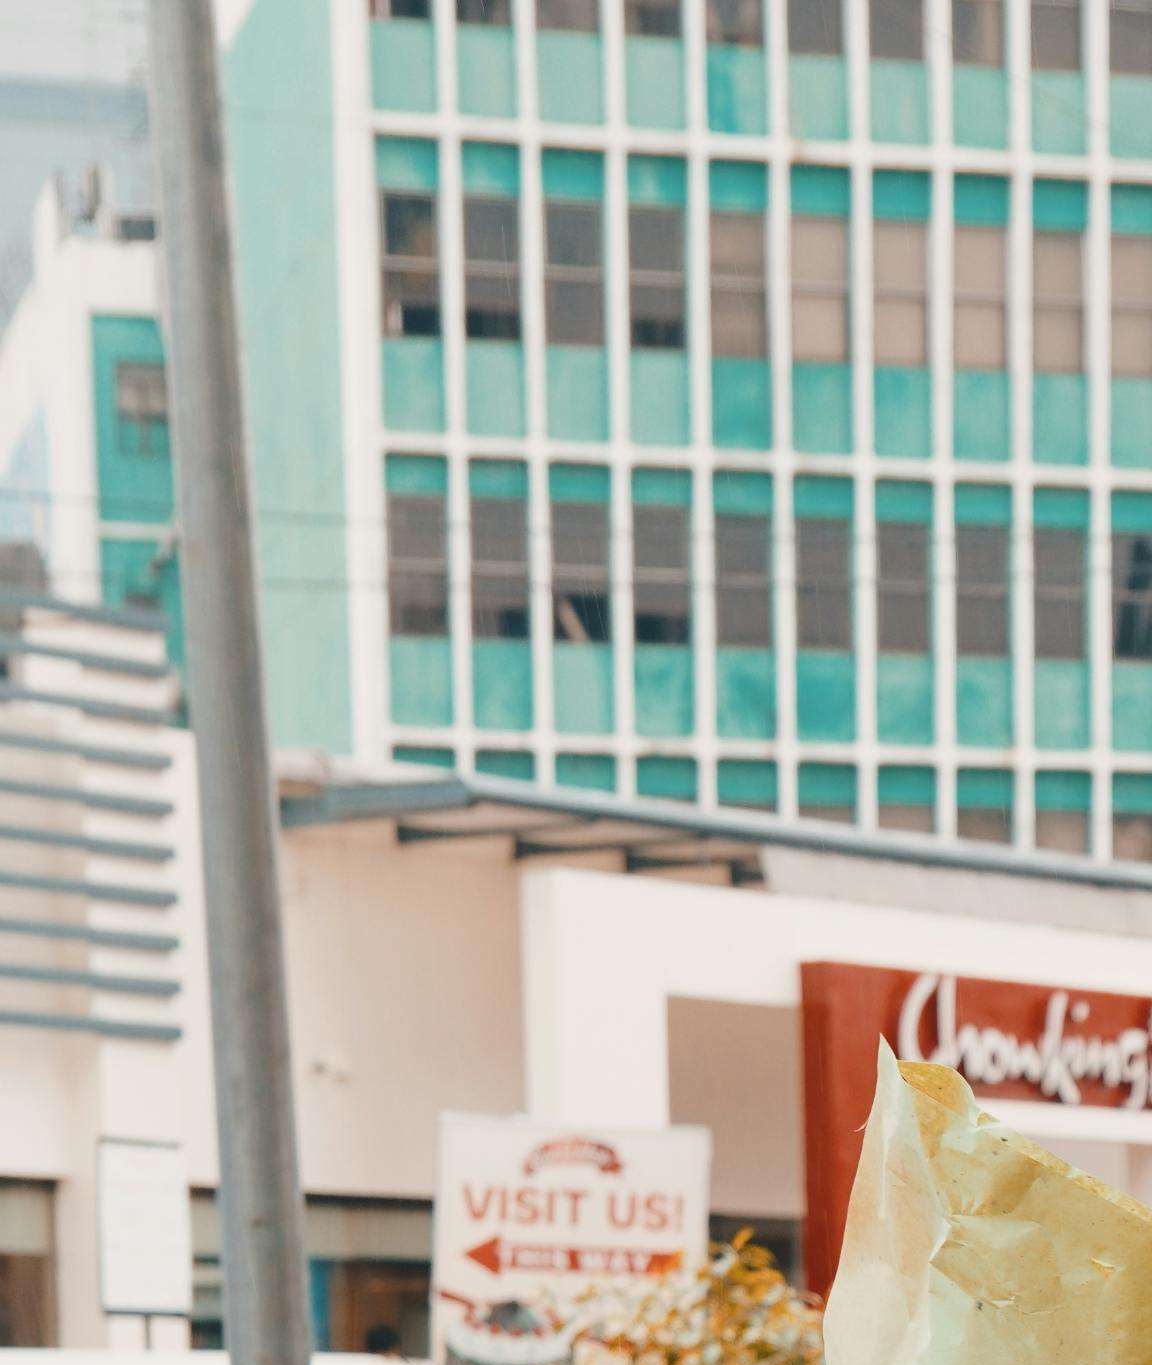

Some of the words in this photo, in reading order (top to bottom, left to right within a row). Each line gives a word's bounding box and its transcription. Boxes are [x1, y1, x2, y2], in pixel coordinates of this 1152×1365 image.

[463, 1184, 588, 1224] VISIT
[608, 1190, 684, 1231] US!
[502, 1246, 569, 1271] THIS
[579, 1248, 653, 1273] WAY
